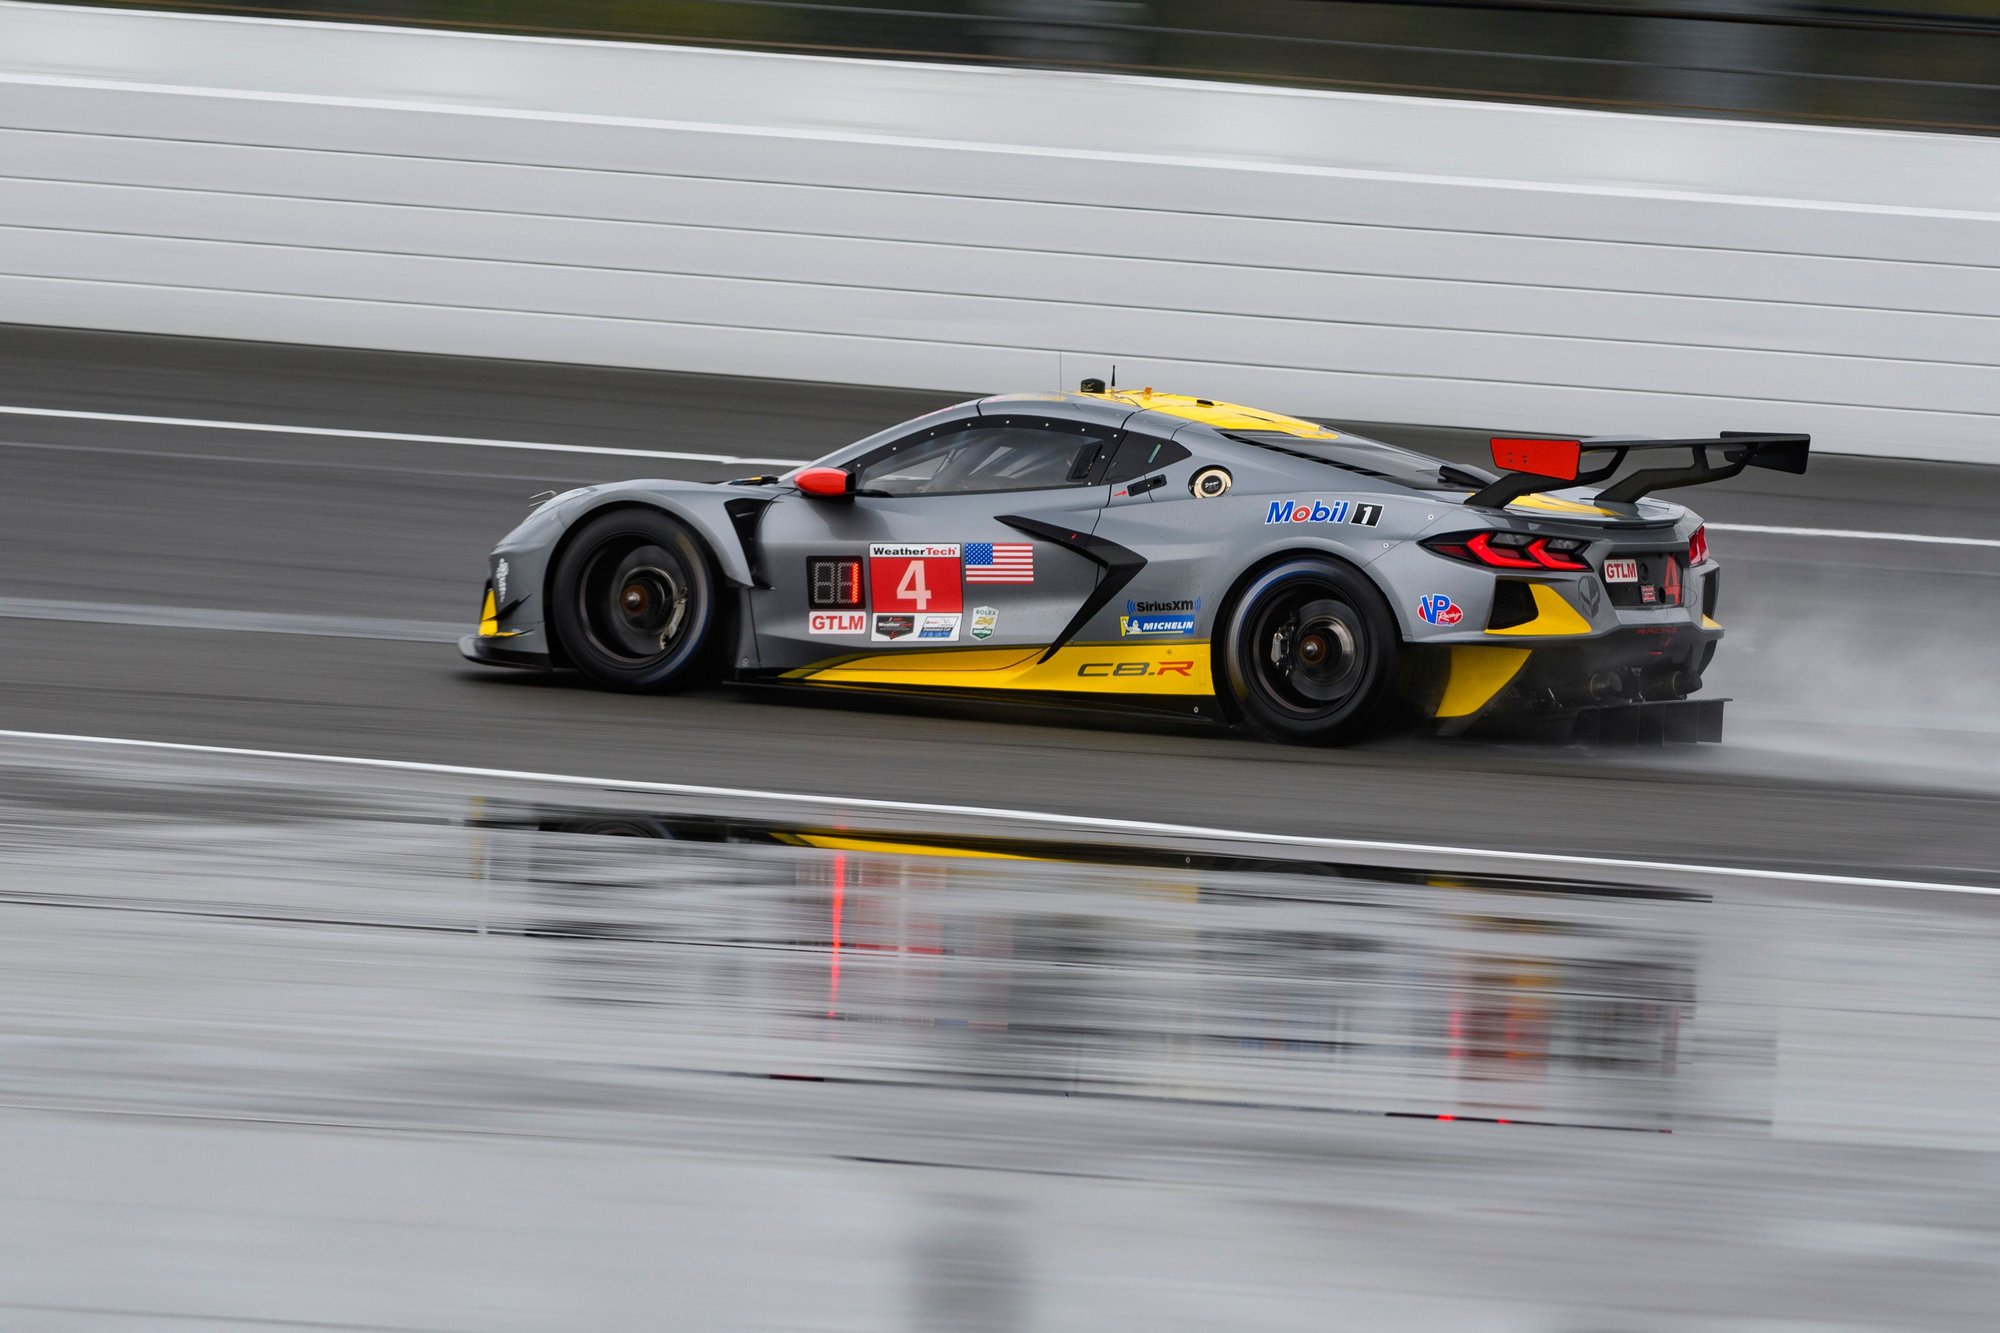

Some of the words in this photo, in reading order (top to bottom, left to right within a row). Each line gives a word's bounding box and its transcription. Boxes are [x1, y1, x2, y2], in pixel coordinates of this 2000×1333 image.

[1265, 500, 1350, 524] Mobil
[873, 546, 956, 556] WeatherTech
[1606, 563, 1637, 579] GTLM
[1663, 553, 1681, 605] 4
[896, 560, 932, 610] 4
[1420, 594, 1451, 625] VP
[812, 614, 864, 631] GTLM
[1142, 620, 1194, 631] MICHELIN
[1077, 660, 1194, 676] C8.R
